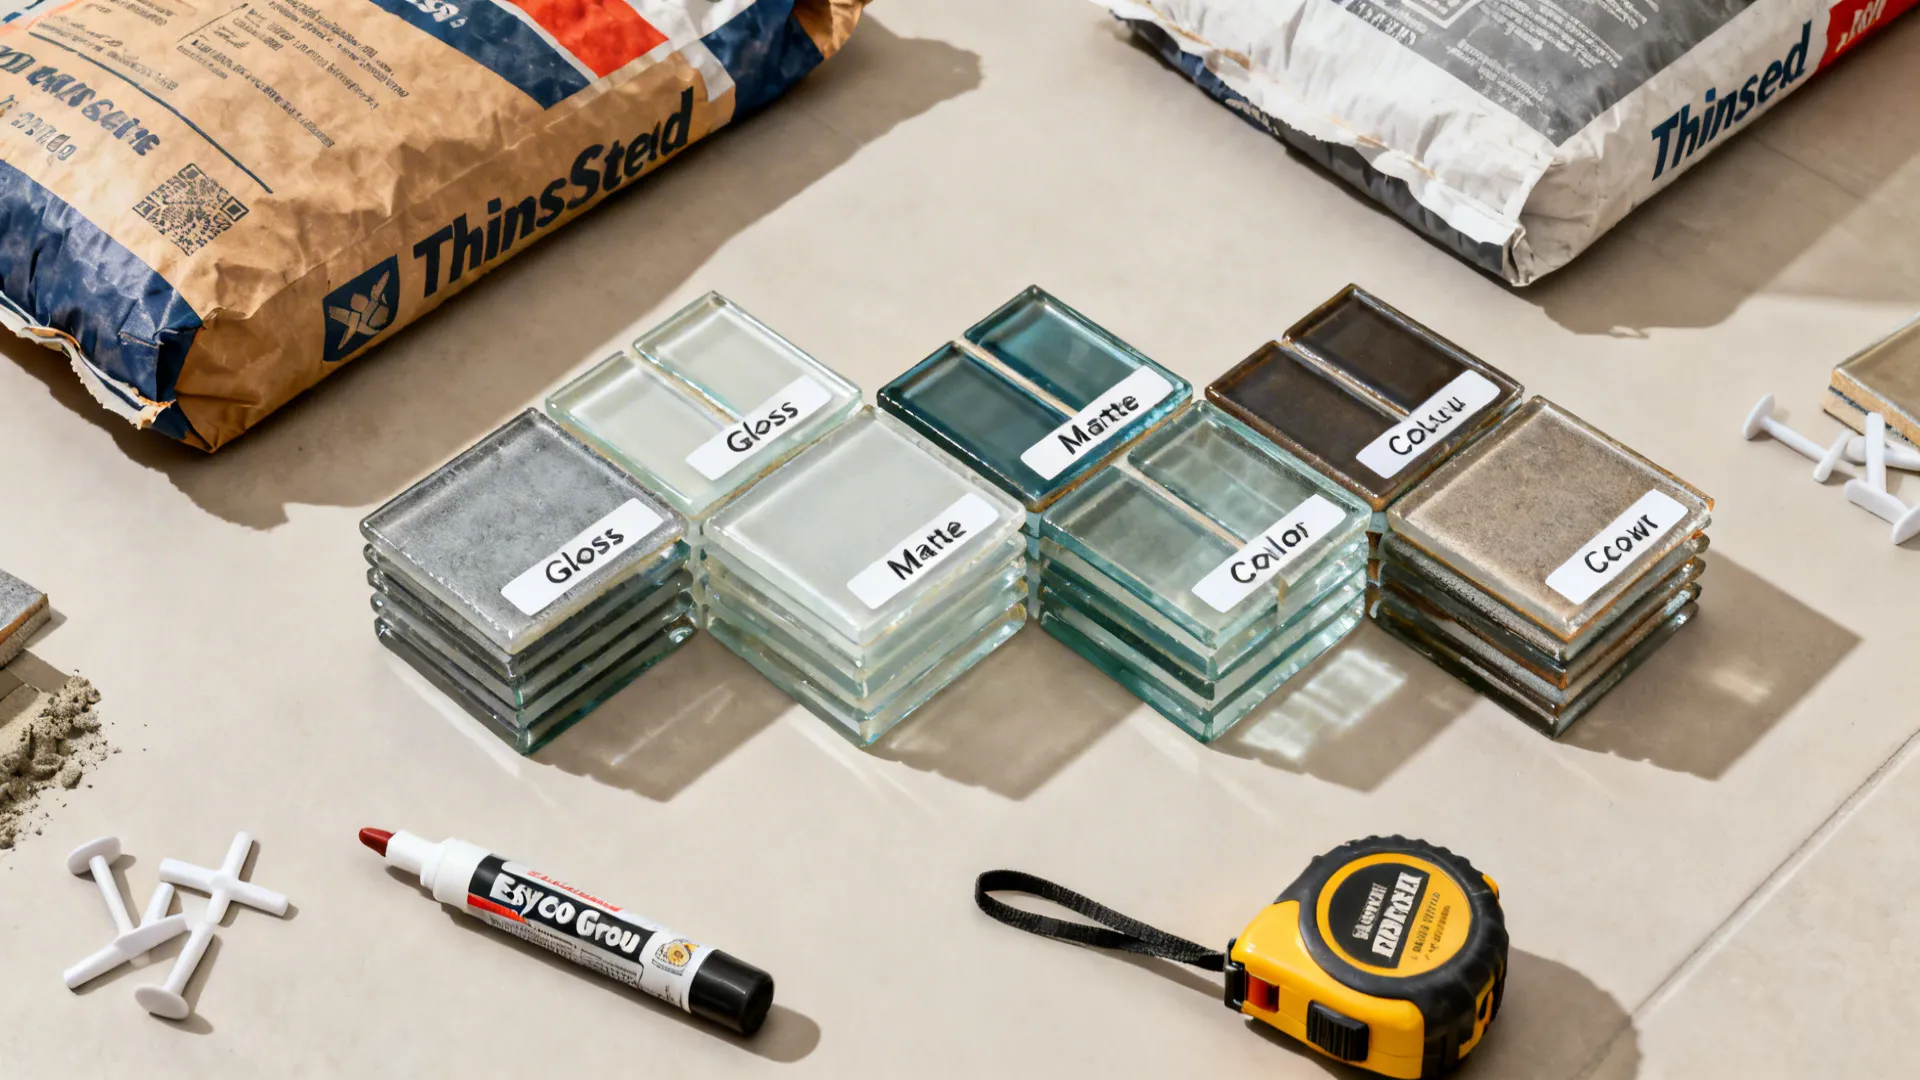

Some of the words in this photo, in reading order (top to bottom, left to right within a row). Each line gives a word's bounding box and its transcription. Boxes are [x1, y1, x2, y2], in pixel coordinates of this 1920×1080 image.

[1651, 20, 1812, 182] Thinsed
[726, 401, 799, 453] Gloss
[545, 528, 625, 584] Gloss
